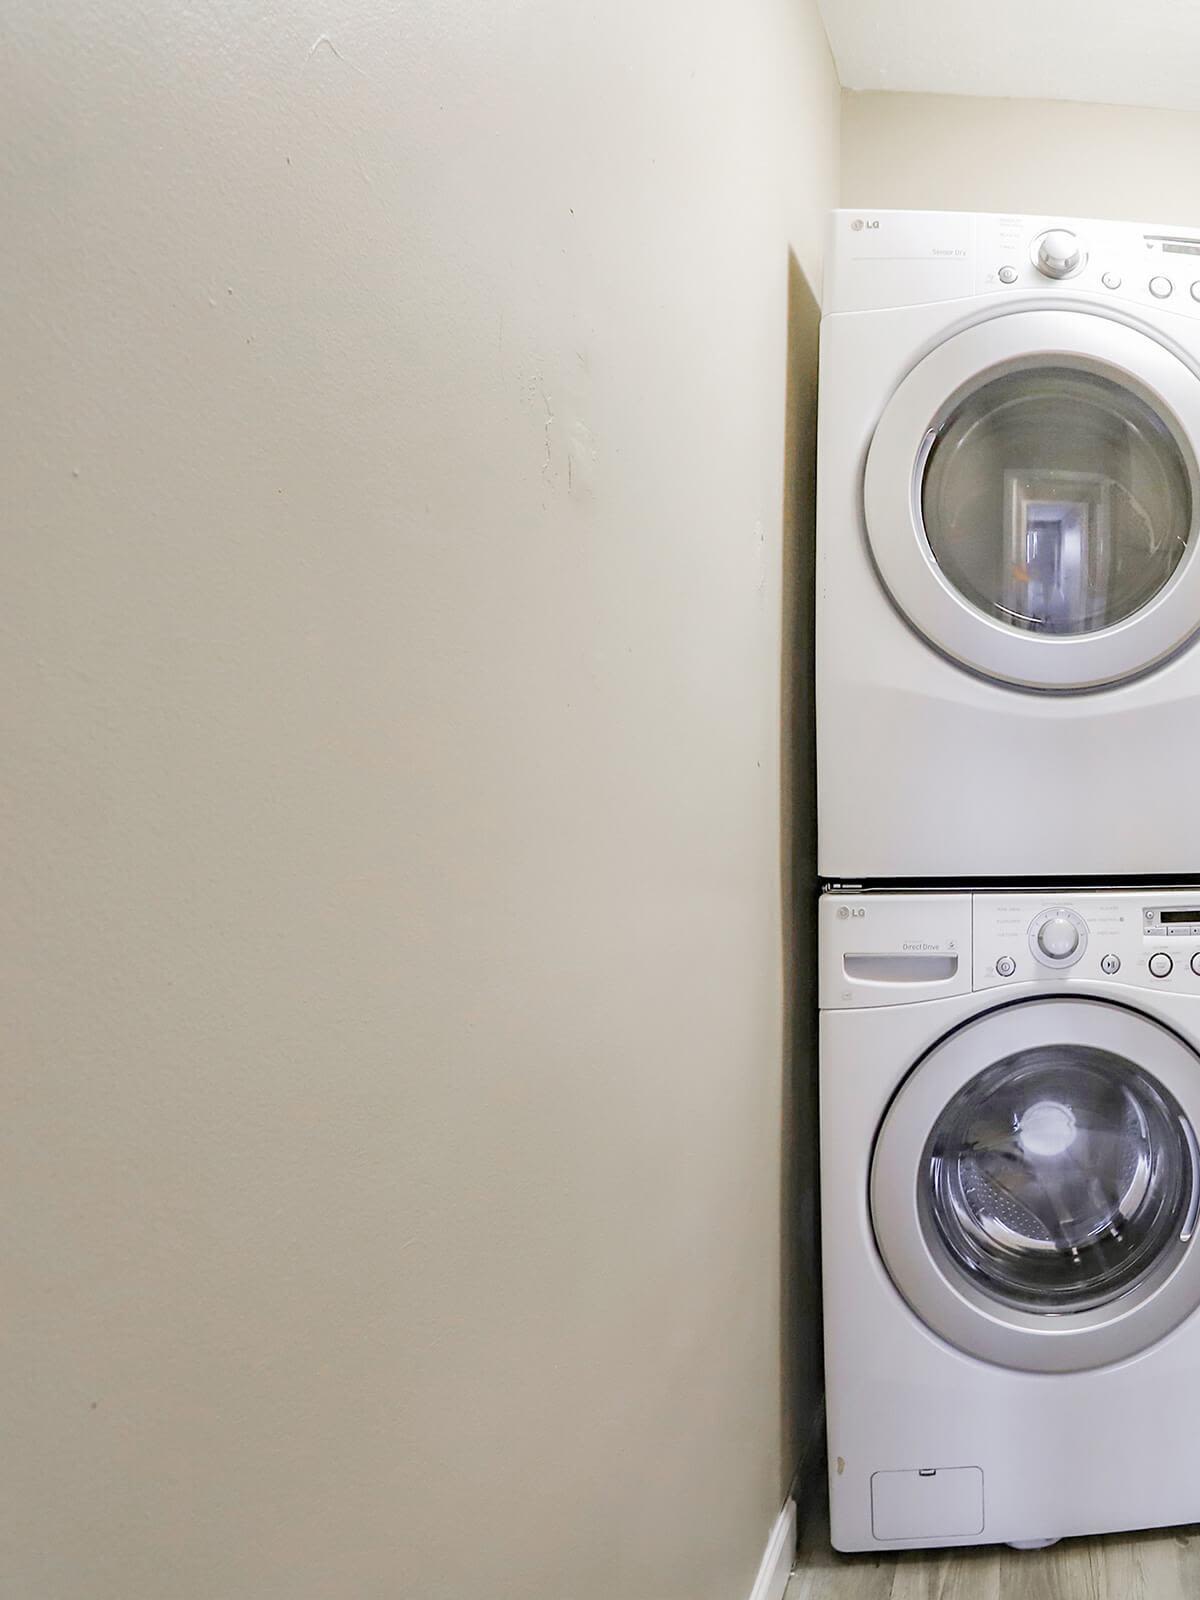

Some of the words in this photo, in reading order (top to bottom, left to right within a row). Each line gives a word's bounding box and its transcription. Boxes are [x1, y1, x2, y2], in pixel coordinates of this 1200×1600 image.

[866, 220, 880, 229] LG
[851, 908, 866, 918] LG
[902, 943, 922, 951] Direct
[922, 943, 940, 951] Drive
